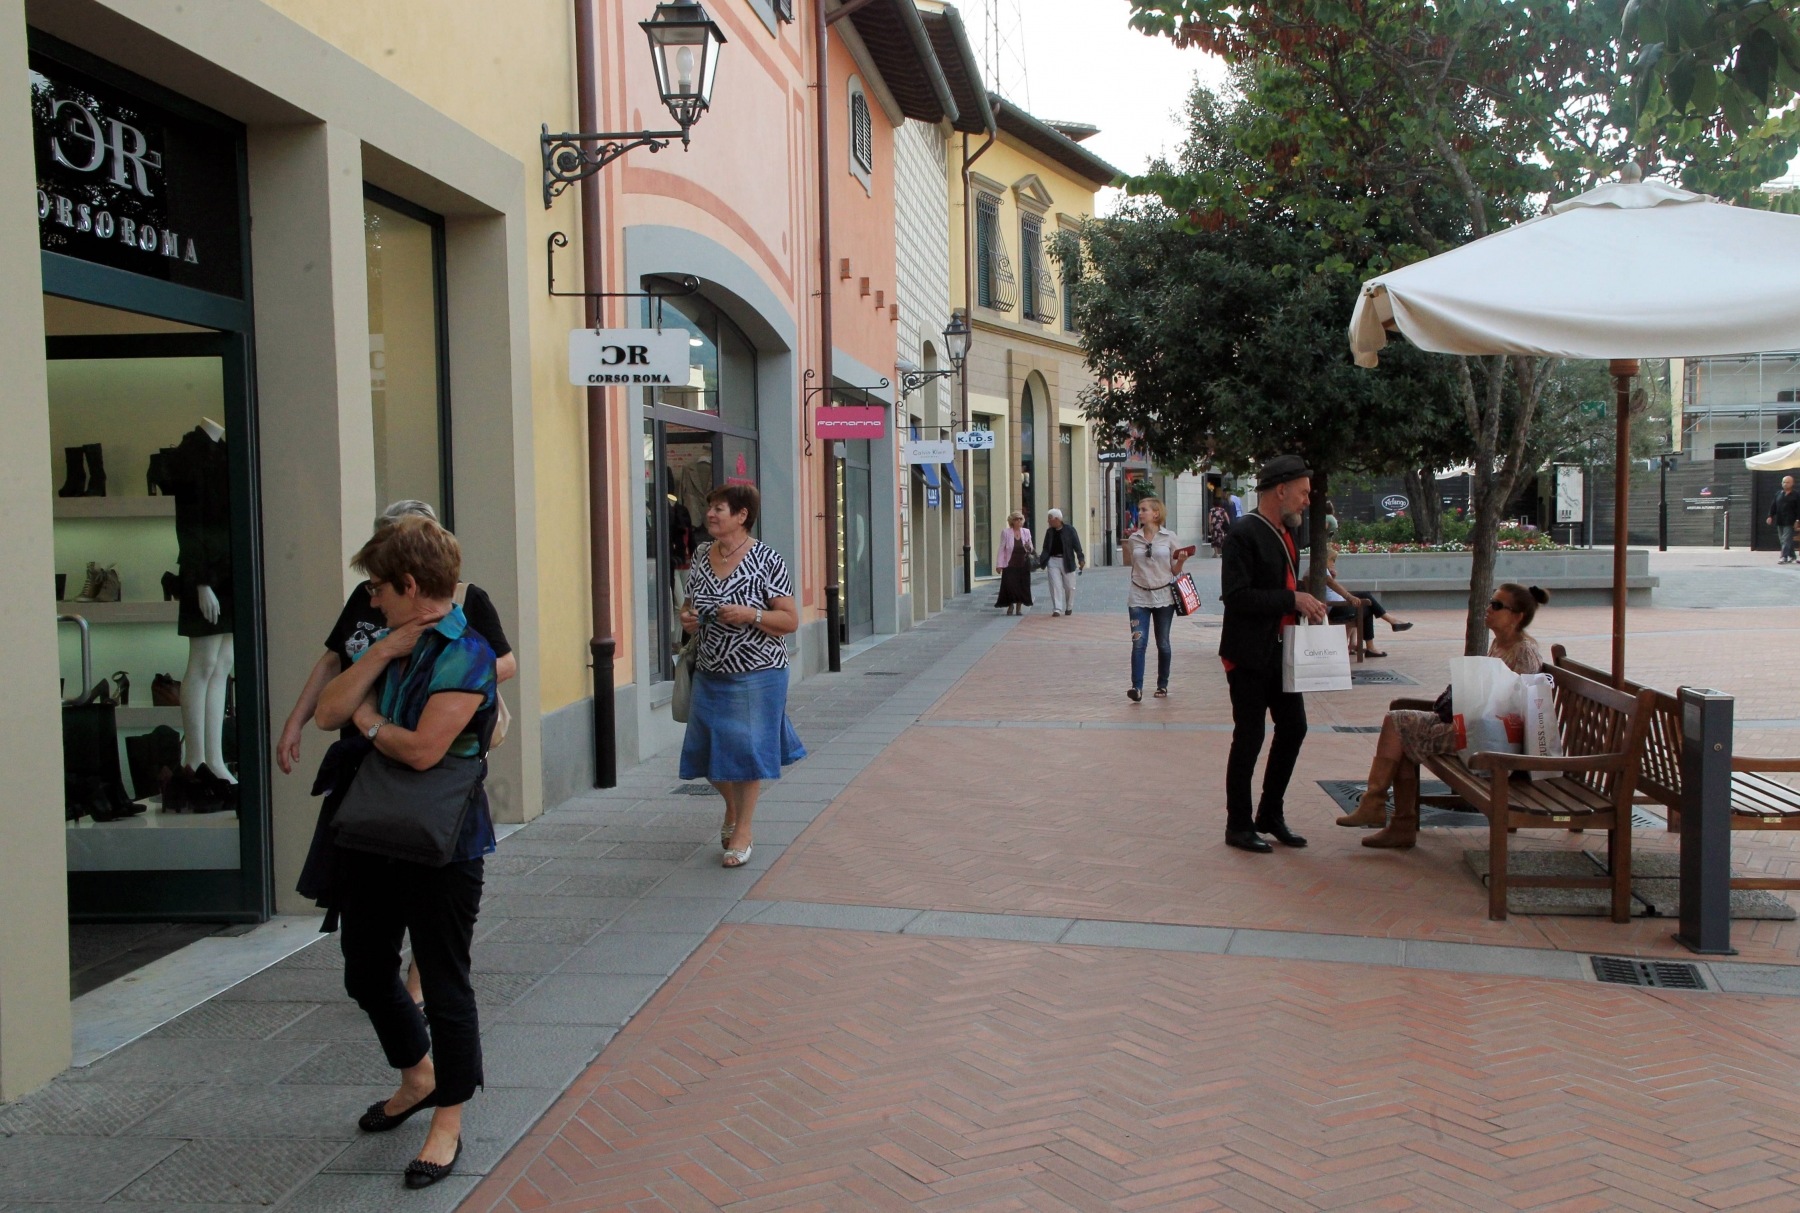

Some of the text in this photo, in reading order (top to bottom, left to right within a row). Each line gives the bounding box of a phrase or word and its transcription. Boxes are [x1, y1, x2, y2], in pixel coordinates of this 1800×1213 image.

[37, 189, 114, 239] ORSO
[588, 374, 671, 383] CORSO ROMA
[1059, 432, 1070, 444] AS
